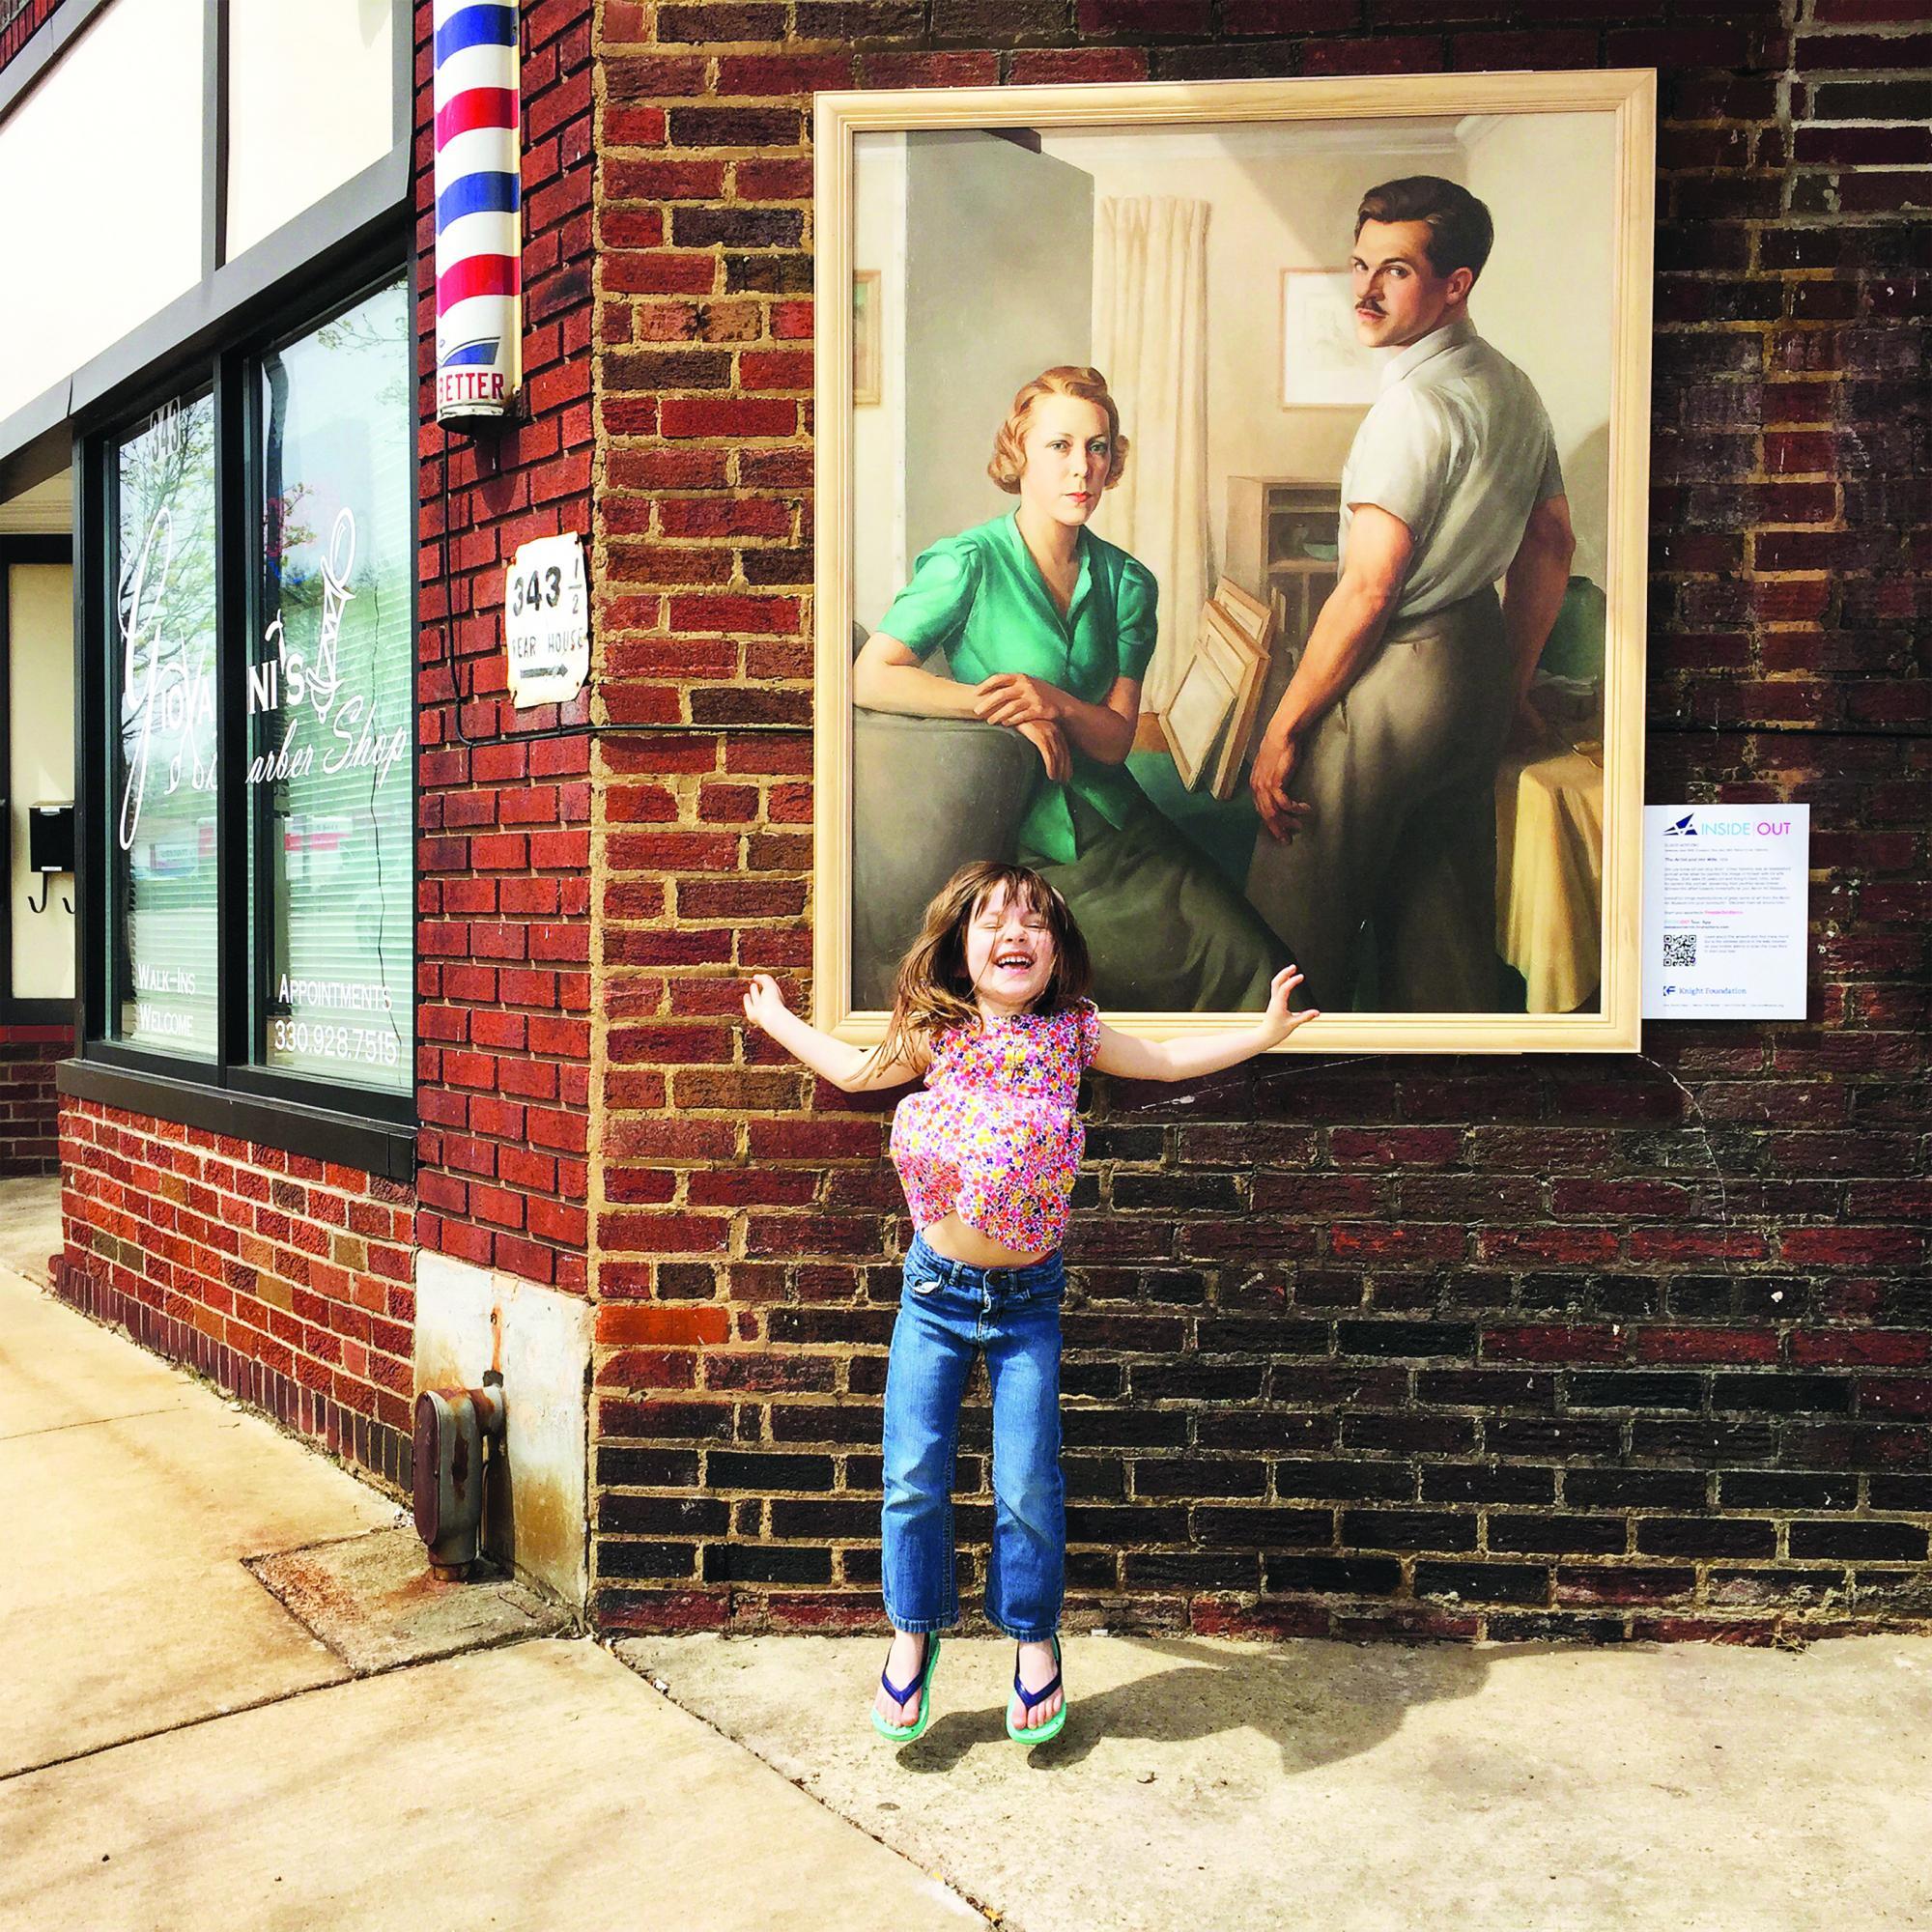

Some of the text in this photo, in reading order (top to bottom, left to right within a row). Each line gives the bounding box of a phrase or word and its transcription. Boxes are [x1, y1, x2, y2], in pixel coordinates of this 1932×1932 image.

[150, 396, 181, 463] 343
[513, 566, 561, 616] 343
[548, 627, 583, 653] HOUSE
[323, 695, 407, 789] Shop
[1701, 822, 1791, 836] INSIDE OUT
[278, 973, 393, 1012] APPOINTMENTS
[1679, 986, 1704, 996] Knight
[1705, 986, 1747, 995] Foundation
[274, 1019, 398, 1065] 330.928.7515
